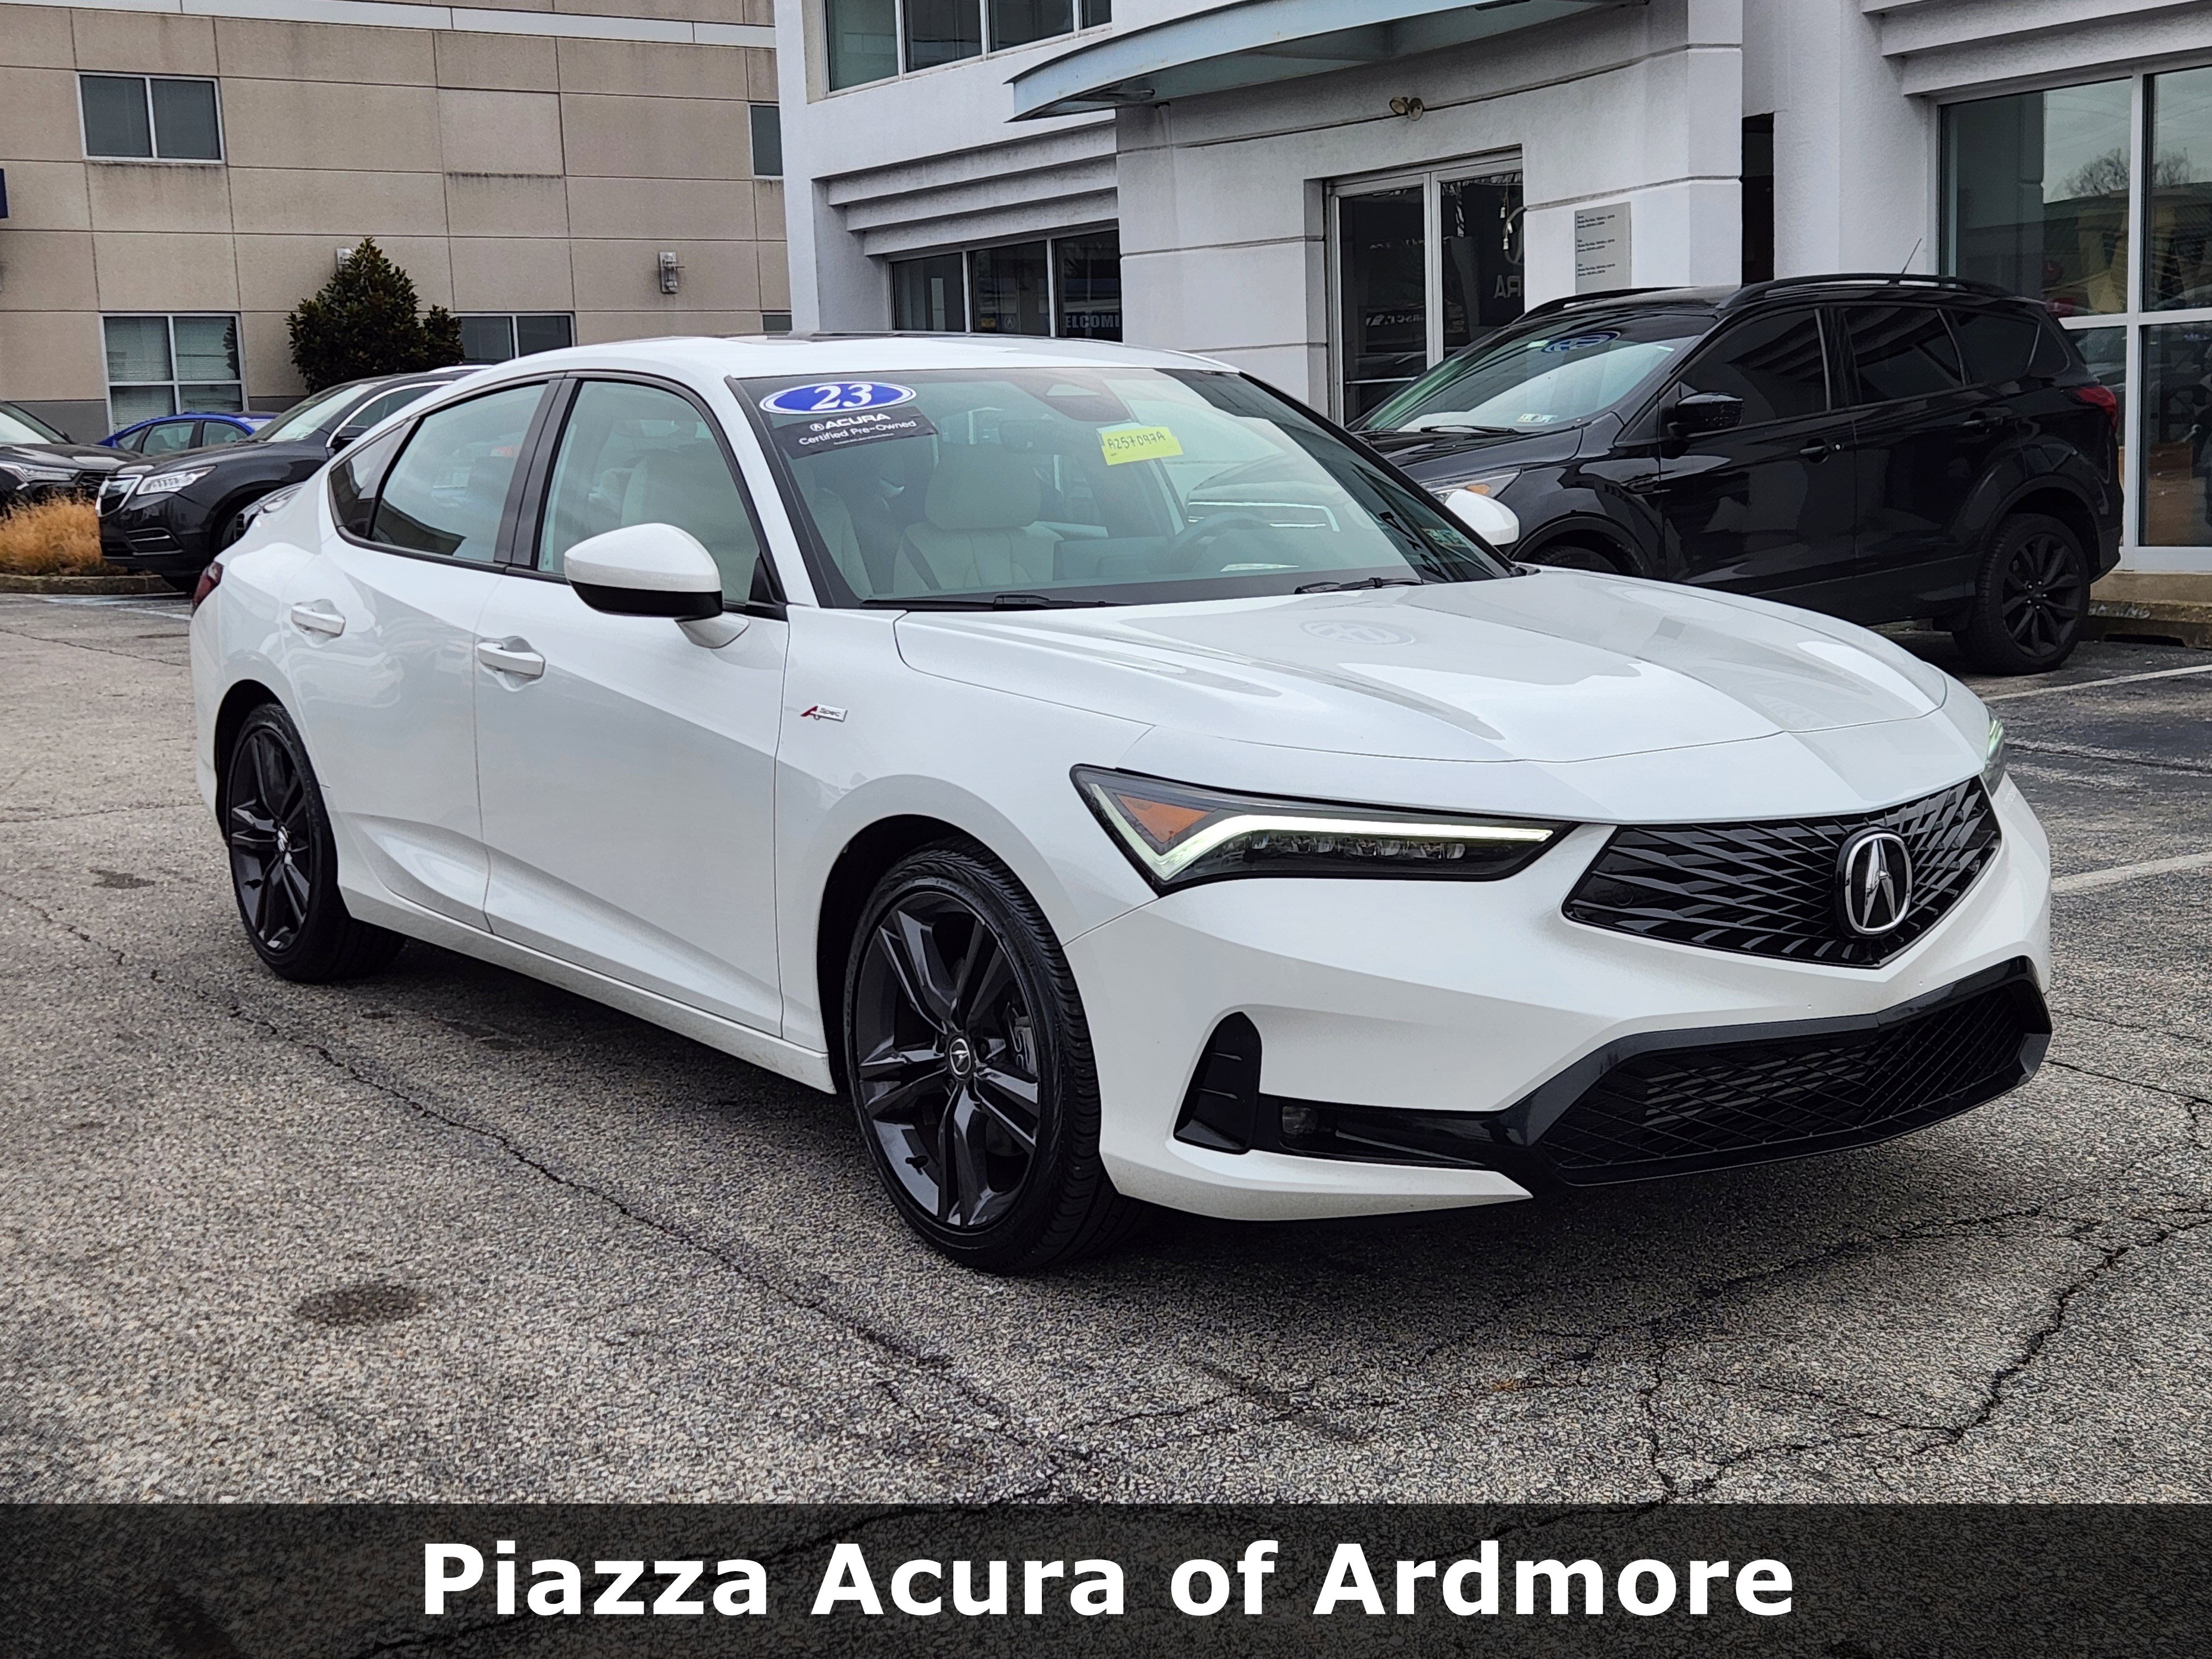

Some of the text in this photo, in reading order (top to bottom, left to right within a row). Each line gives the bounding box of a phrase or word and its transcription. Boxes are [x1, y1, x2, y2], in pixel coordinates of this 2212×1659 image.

[811, 384, 873, 410] 23
[799, 430, 849, 445] Certified
[850, 420, 917, 435] Pre-Owned
[825, 413, 891, 429] ACURA
